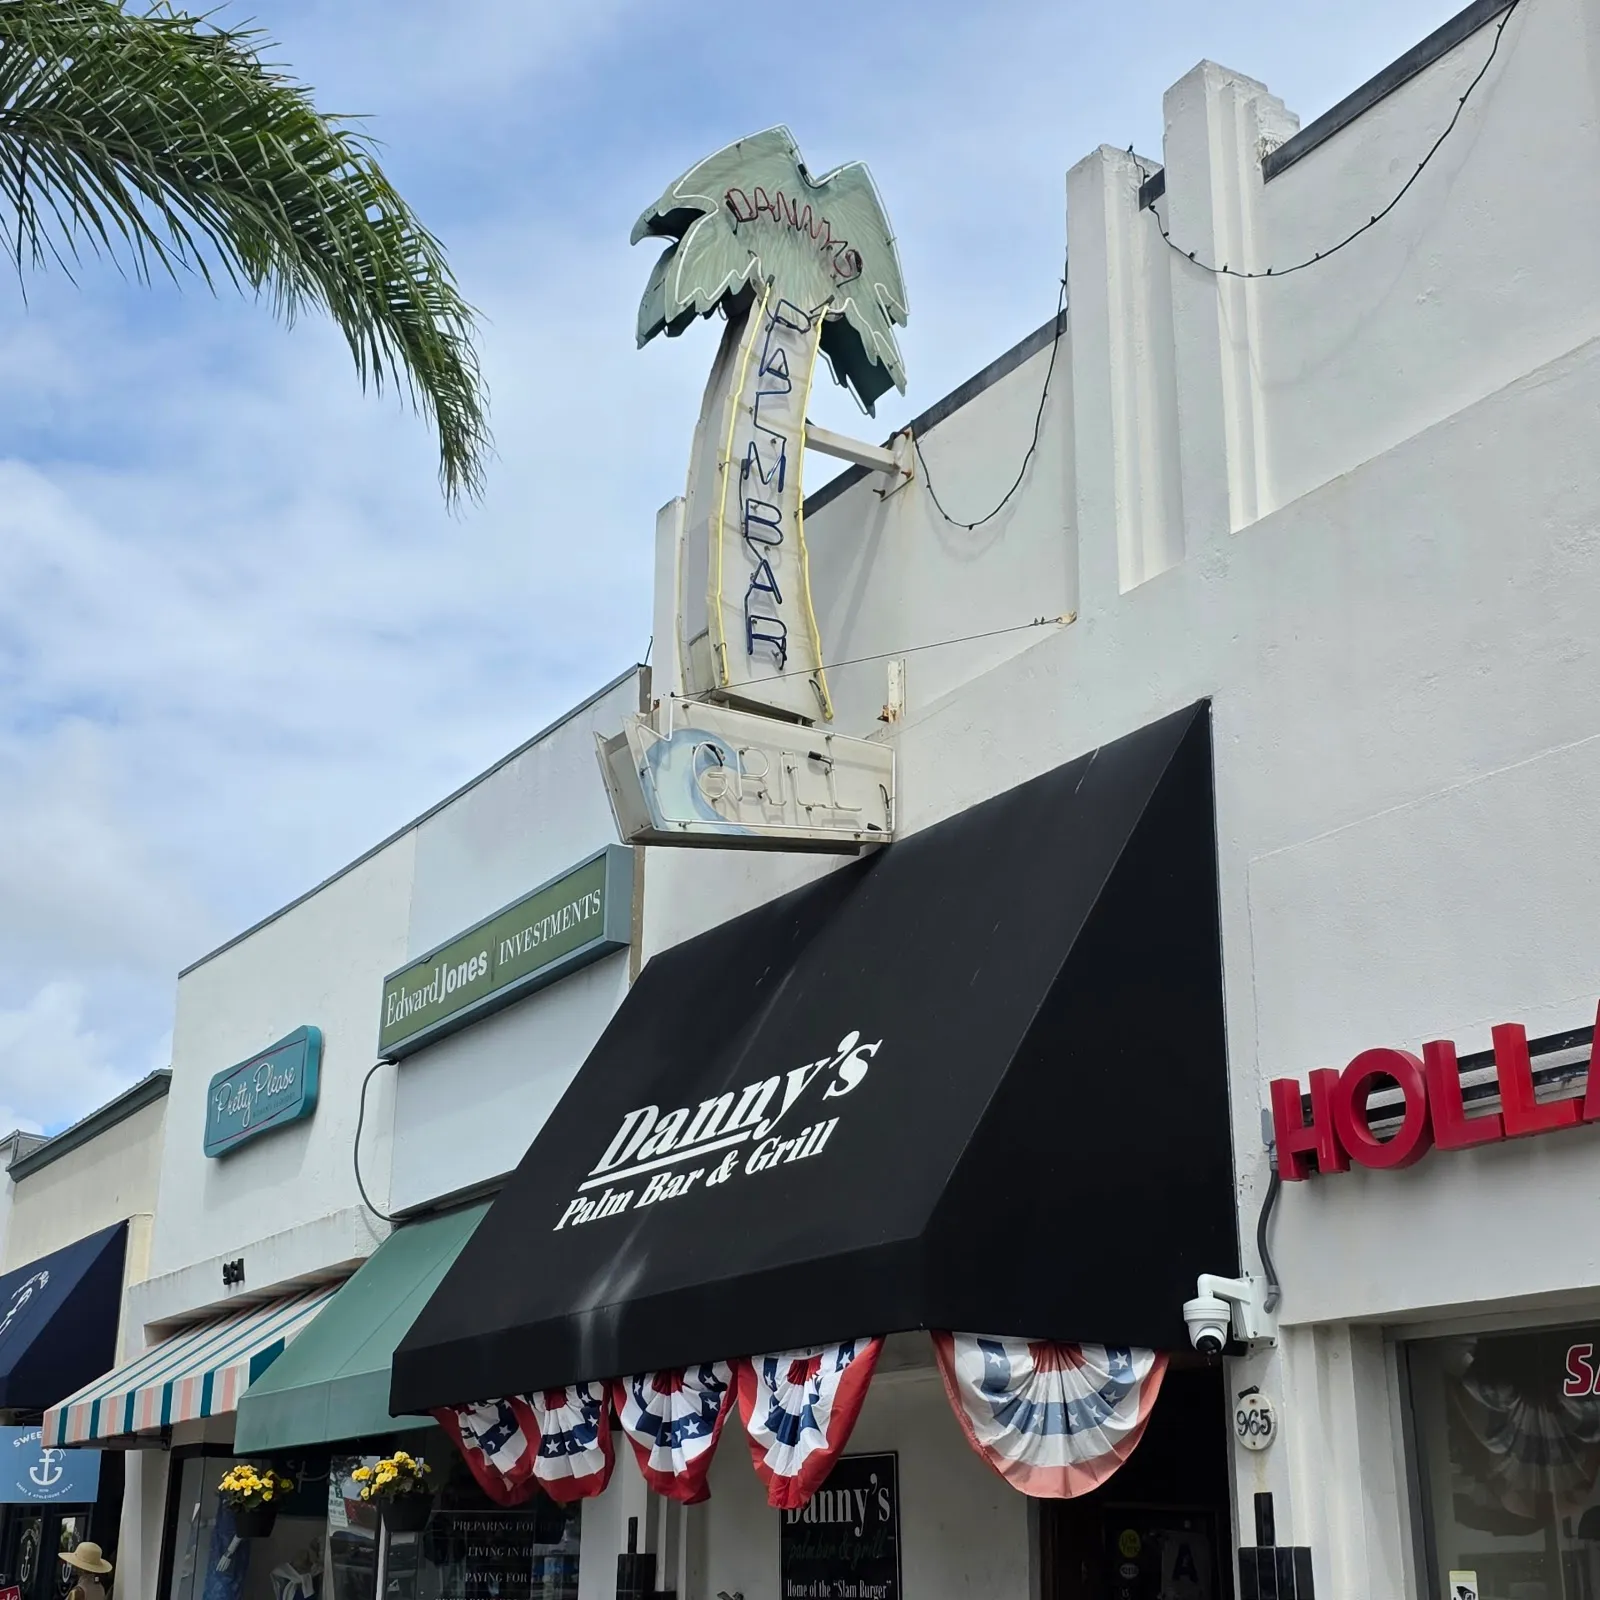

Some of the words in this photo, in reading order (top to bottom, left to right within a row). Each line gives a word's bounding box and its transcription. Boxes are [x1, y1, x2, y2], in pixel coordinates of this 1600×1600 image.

[692, 741, 862, 811] GRILL
[385, 967, 439, 1028] Edward
[437, 950, 488, 1004] Jones
[499, 888, 601, 966] INVESTMENTS
[215, 1083, 254, 1127] Pretty
[253, 1062, 296, 1105] Please
[588, 1030, 883, 1176] Danny's
[1270, 999, 1600, 1181] HOLL
[553, 1188, 635, 1231] Palm
[633, 1167, 704, 1209] Bar
[705, 1149, 739, 1187] &
[744, 1117, 840, 1175] Grill
[13, 1431, 43, 1447] SWEE
[1236, 1408, 1272, 1436] 965
[453, 1520, 513, 1531] PREPARING
[468, 1546, 504, 1557] LIVING
[507, 1547, 518, 1557] IN
[465, 1572, 503, 1583] PAYING
[506, 1572, 528, 1583] FOR
[787, 1579, 808, 1597] Home
[809, 1579, 817, 1597] of
[819, 1580, 831, 1597] the
